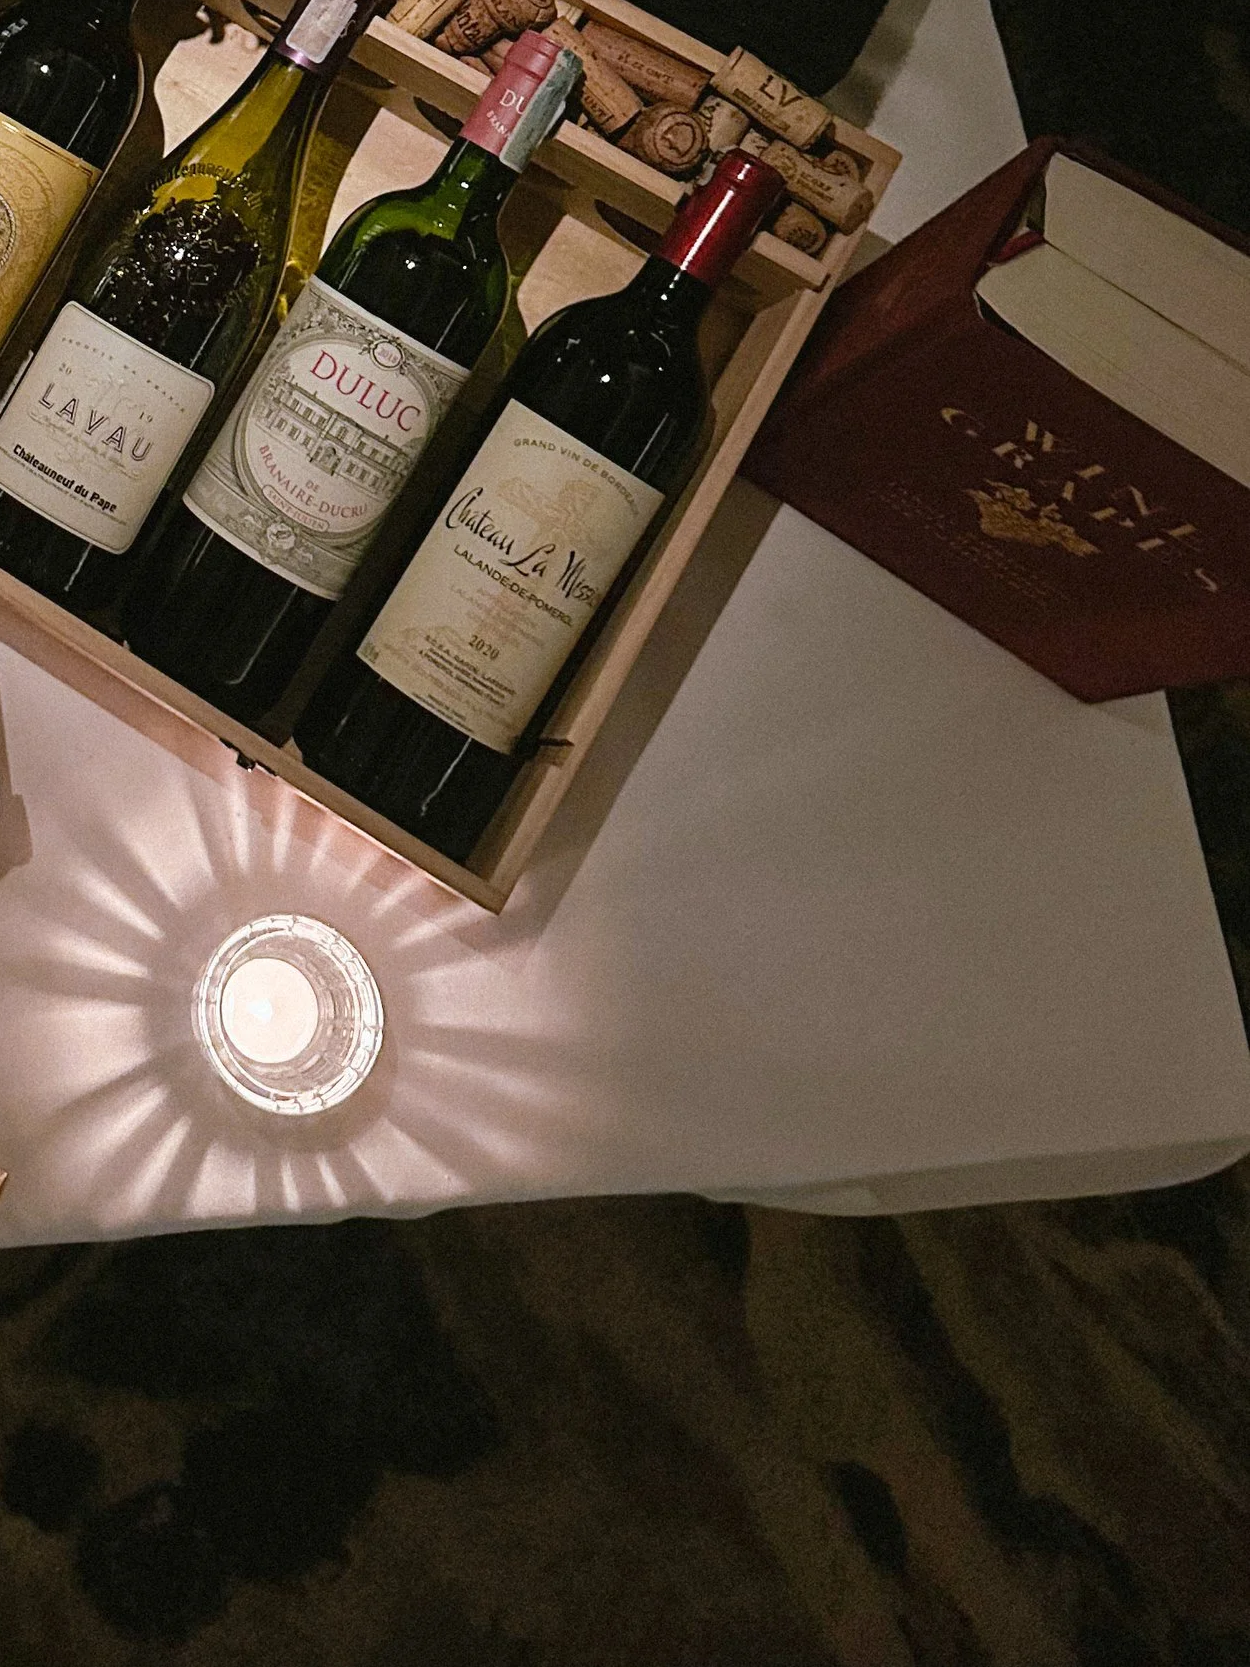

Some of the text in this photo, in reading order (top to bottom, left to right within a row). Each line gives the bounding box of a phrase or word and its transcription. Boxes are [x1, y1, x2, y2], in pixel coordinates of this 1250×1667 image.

[500, 88, 526, 115] DU
[310, 350, 421, 432] DULUC
[38, 382, 155, 463] LAVAU
[513, 437, 556, 453] GRAND
[560, 445, 581, 462] VIN
[74, 481, 90, 499] du
[90, 491, 118, 514] Pape
[259, 445, 367, 518] BRANAIRE-DUCRU
[499, 543, 555, 579] La
[454, 544, 574, 627] LALANDE-DE-POMEROL
[468, 633, 499, 661] 2020
